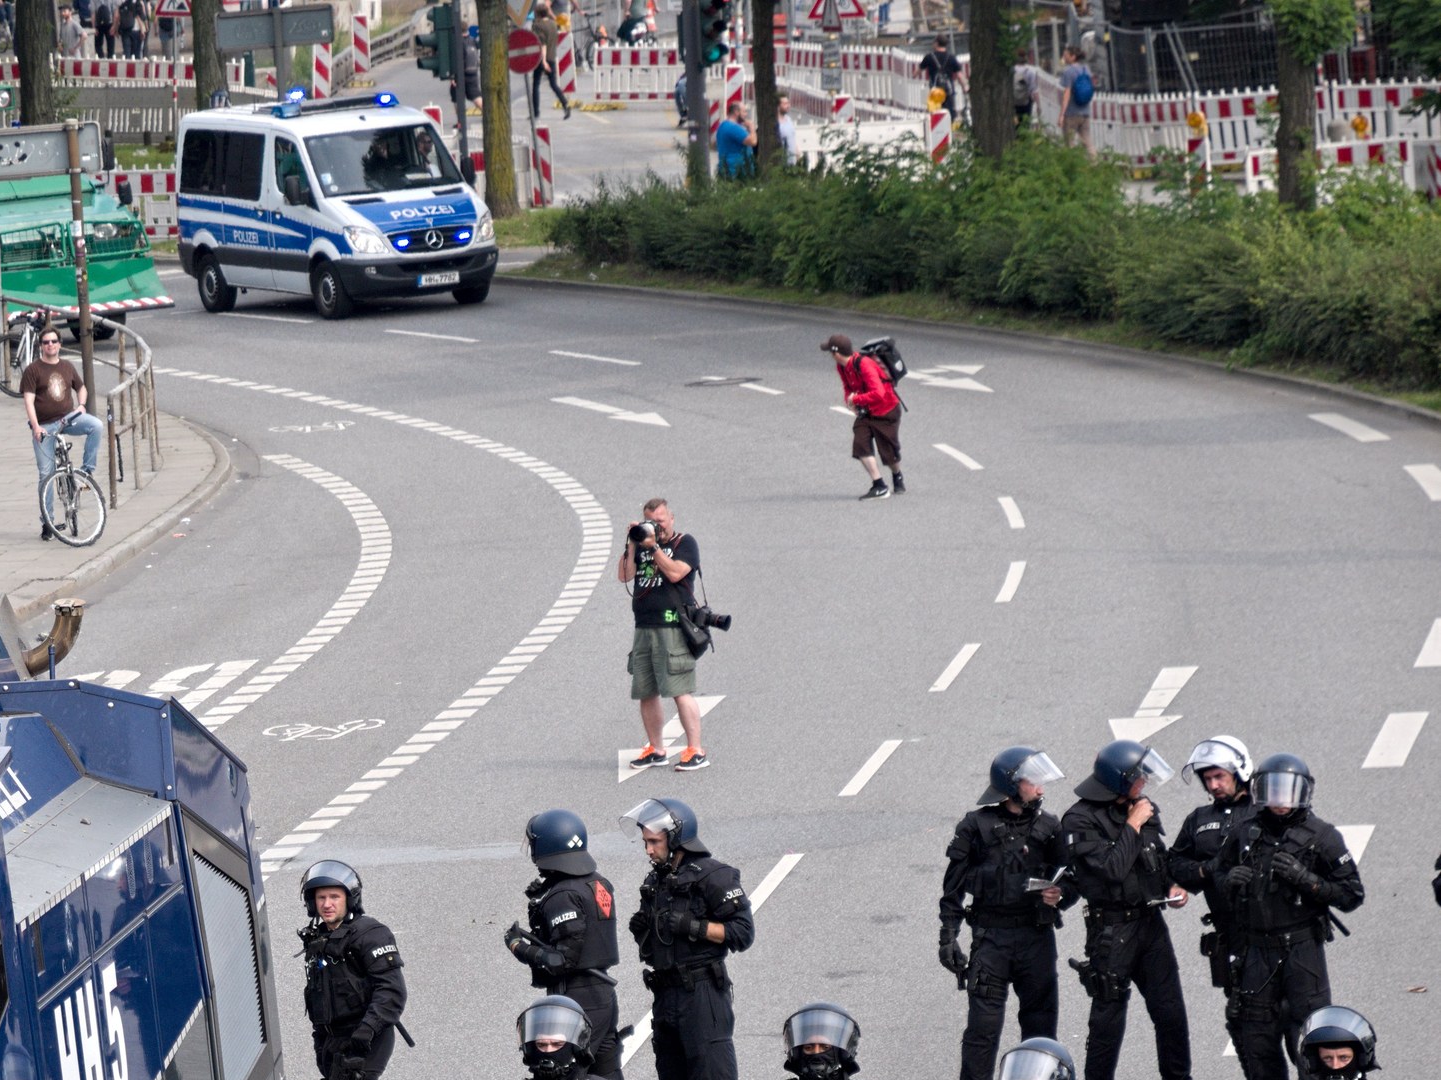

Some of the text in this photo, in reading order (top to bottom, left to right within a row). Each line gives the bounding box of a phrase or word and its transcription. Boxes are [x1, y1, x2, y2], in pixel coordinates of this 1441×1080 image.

[390, 204, 455, 221] POLIZEI
[233, 230, 259, 244] POLIZEI
[551, 911, 578, 927] POLIZEI
